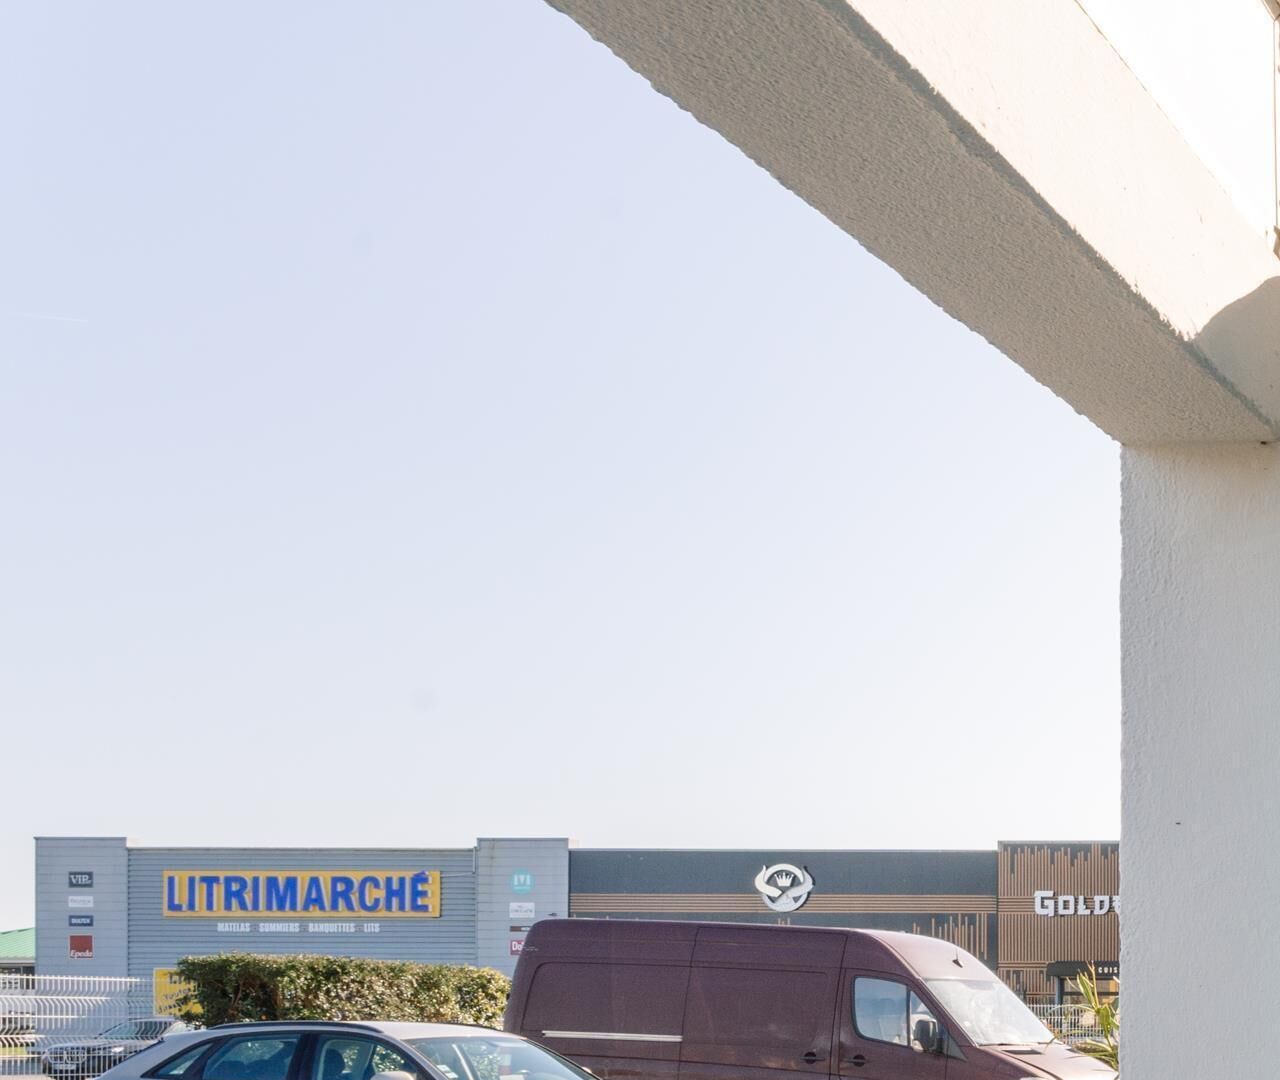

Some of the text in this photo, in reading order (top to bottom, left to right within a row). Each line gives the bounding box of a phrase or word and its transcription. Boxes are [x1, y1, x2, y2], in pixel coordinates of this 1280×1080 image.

[167, 870, 431, 912] LITRIMARCHÉ
[216, 923, 380, 933] MATELAS SOMMIERS BANQUETTES LITS
